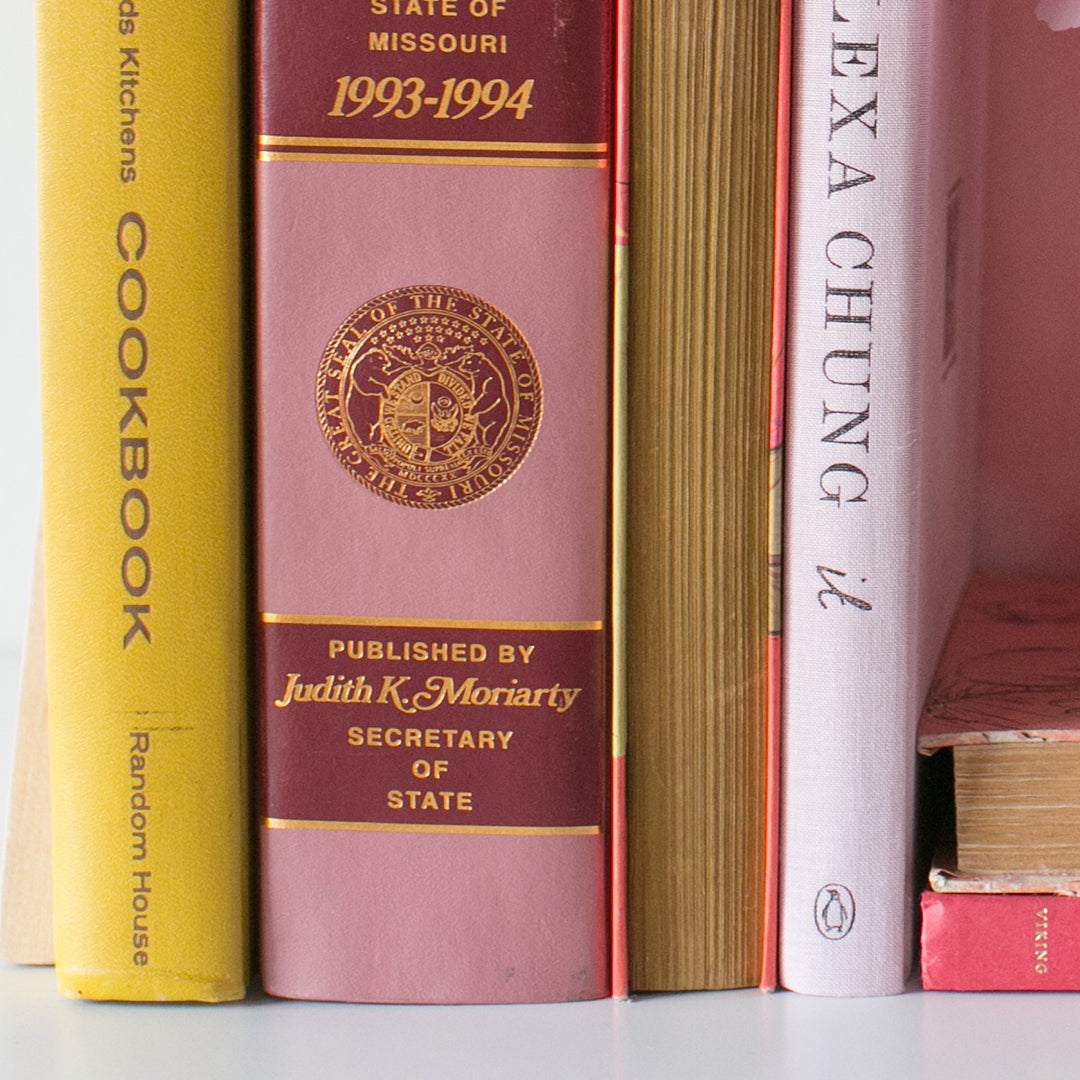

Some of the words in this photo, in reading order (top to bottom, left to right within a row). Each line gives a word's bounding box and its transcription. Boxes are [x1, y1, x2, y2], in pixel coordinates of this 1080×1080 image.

[368, 32, 508, 54] MISSOURI
[118, 47, 141, 185] Kitchens
[327, 75, 535, 121] 1993-1994
[369, 301, 400, 322] OF
[410, 294, 459, 313] THE
[327, 326, 368, 380] SEAL
[468, 306, 527, 365] STATE
[391, 372, 422, 400] STAND
[436, 372, 473, 409] DIVIDED
[517, 373, 534, 402] OF
[819, 230, 875, 510] CHUNG
[116, 211, 152, 651] COOKBOOK
[325, 389, 362, 467] GREAT
[449, 413, 534, 500] MISSOURI
[365, 466, 409, 500] THE
[328, 639, 488, 663] PUBLISHED
[498, 645, 536, 665] BY
[274, 673, 373, 708] Judith
[378, 675, 417, 714] K.
[412, 675, 582, 713] Moriarty
[347, 727, 514, 750] SECRETARY
[411, 759, 449, 780] OF
[129, 731, 152, 861] Random
[387, 790, 473, 811] STATE
[132, 871, 153, 968] House
[1034, 907, 1049, 975] VIKING
